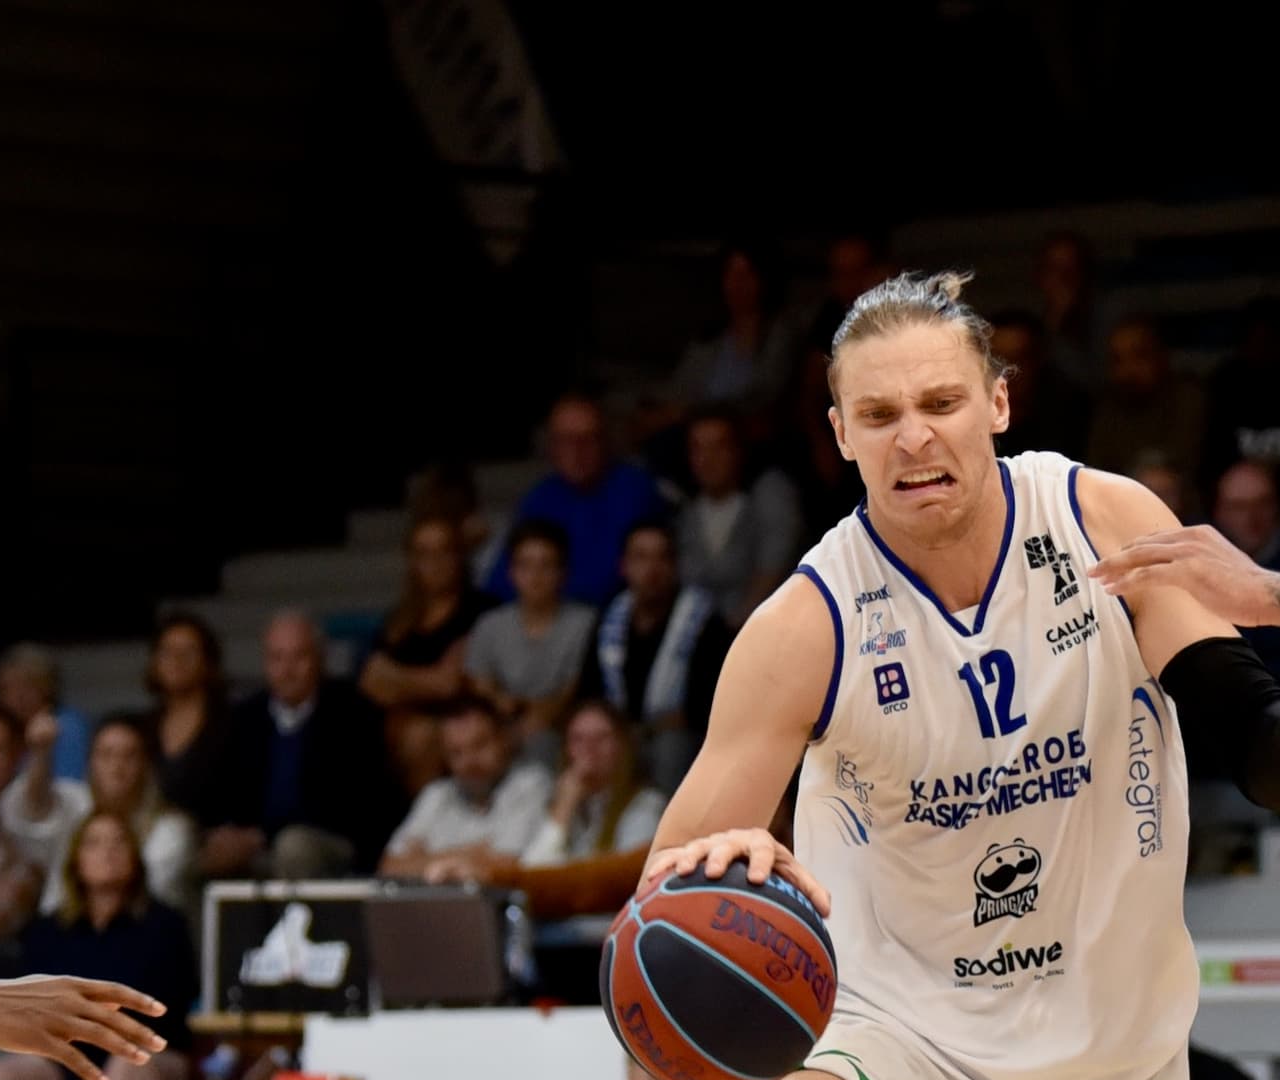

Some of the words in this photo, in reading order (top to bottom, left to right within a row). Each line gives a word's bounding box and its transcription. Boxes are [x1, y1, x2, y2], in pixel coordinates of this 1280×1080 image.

[883, 701, 909, 716] arco
[957, 649, 1027, 739] 12
[953, 941, 1063, 978] sodiwe
